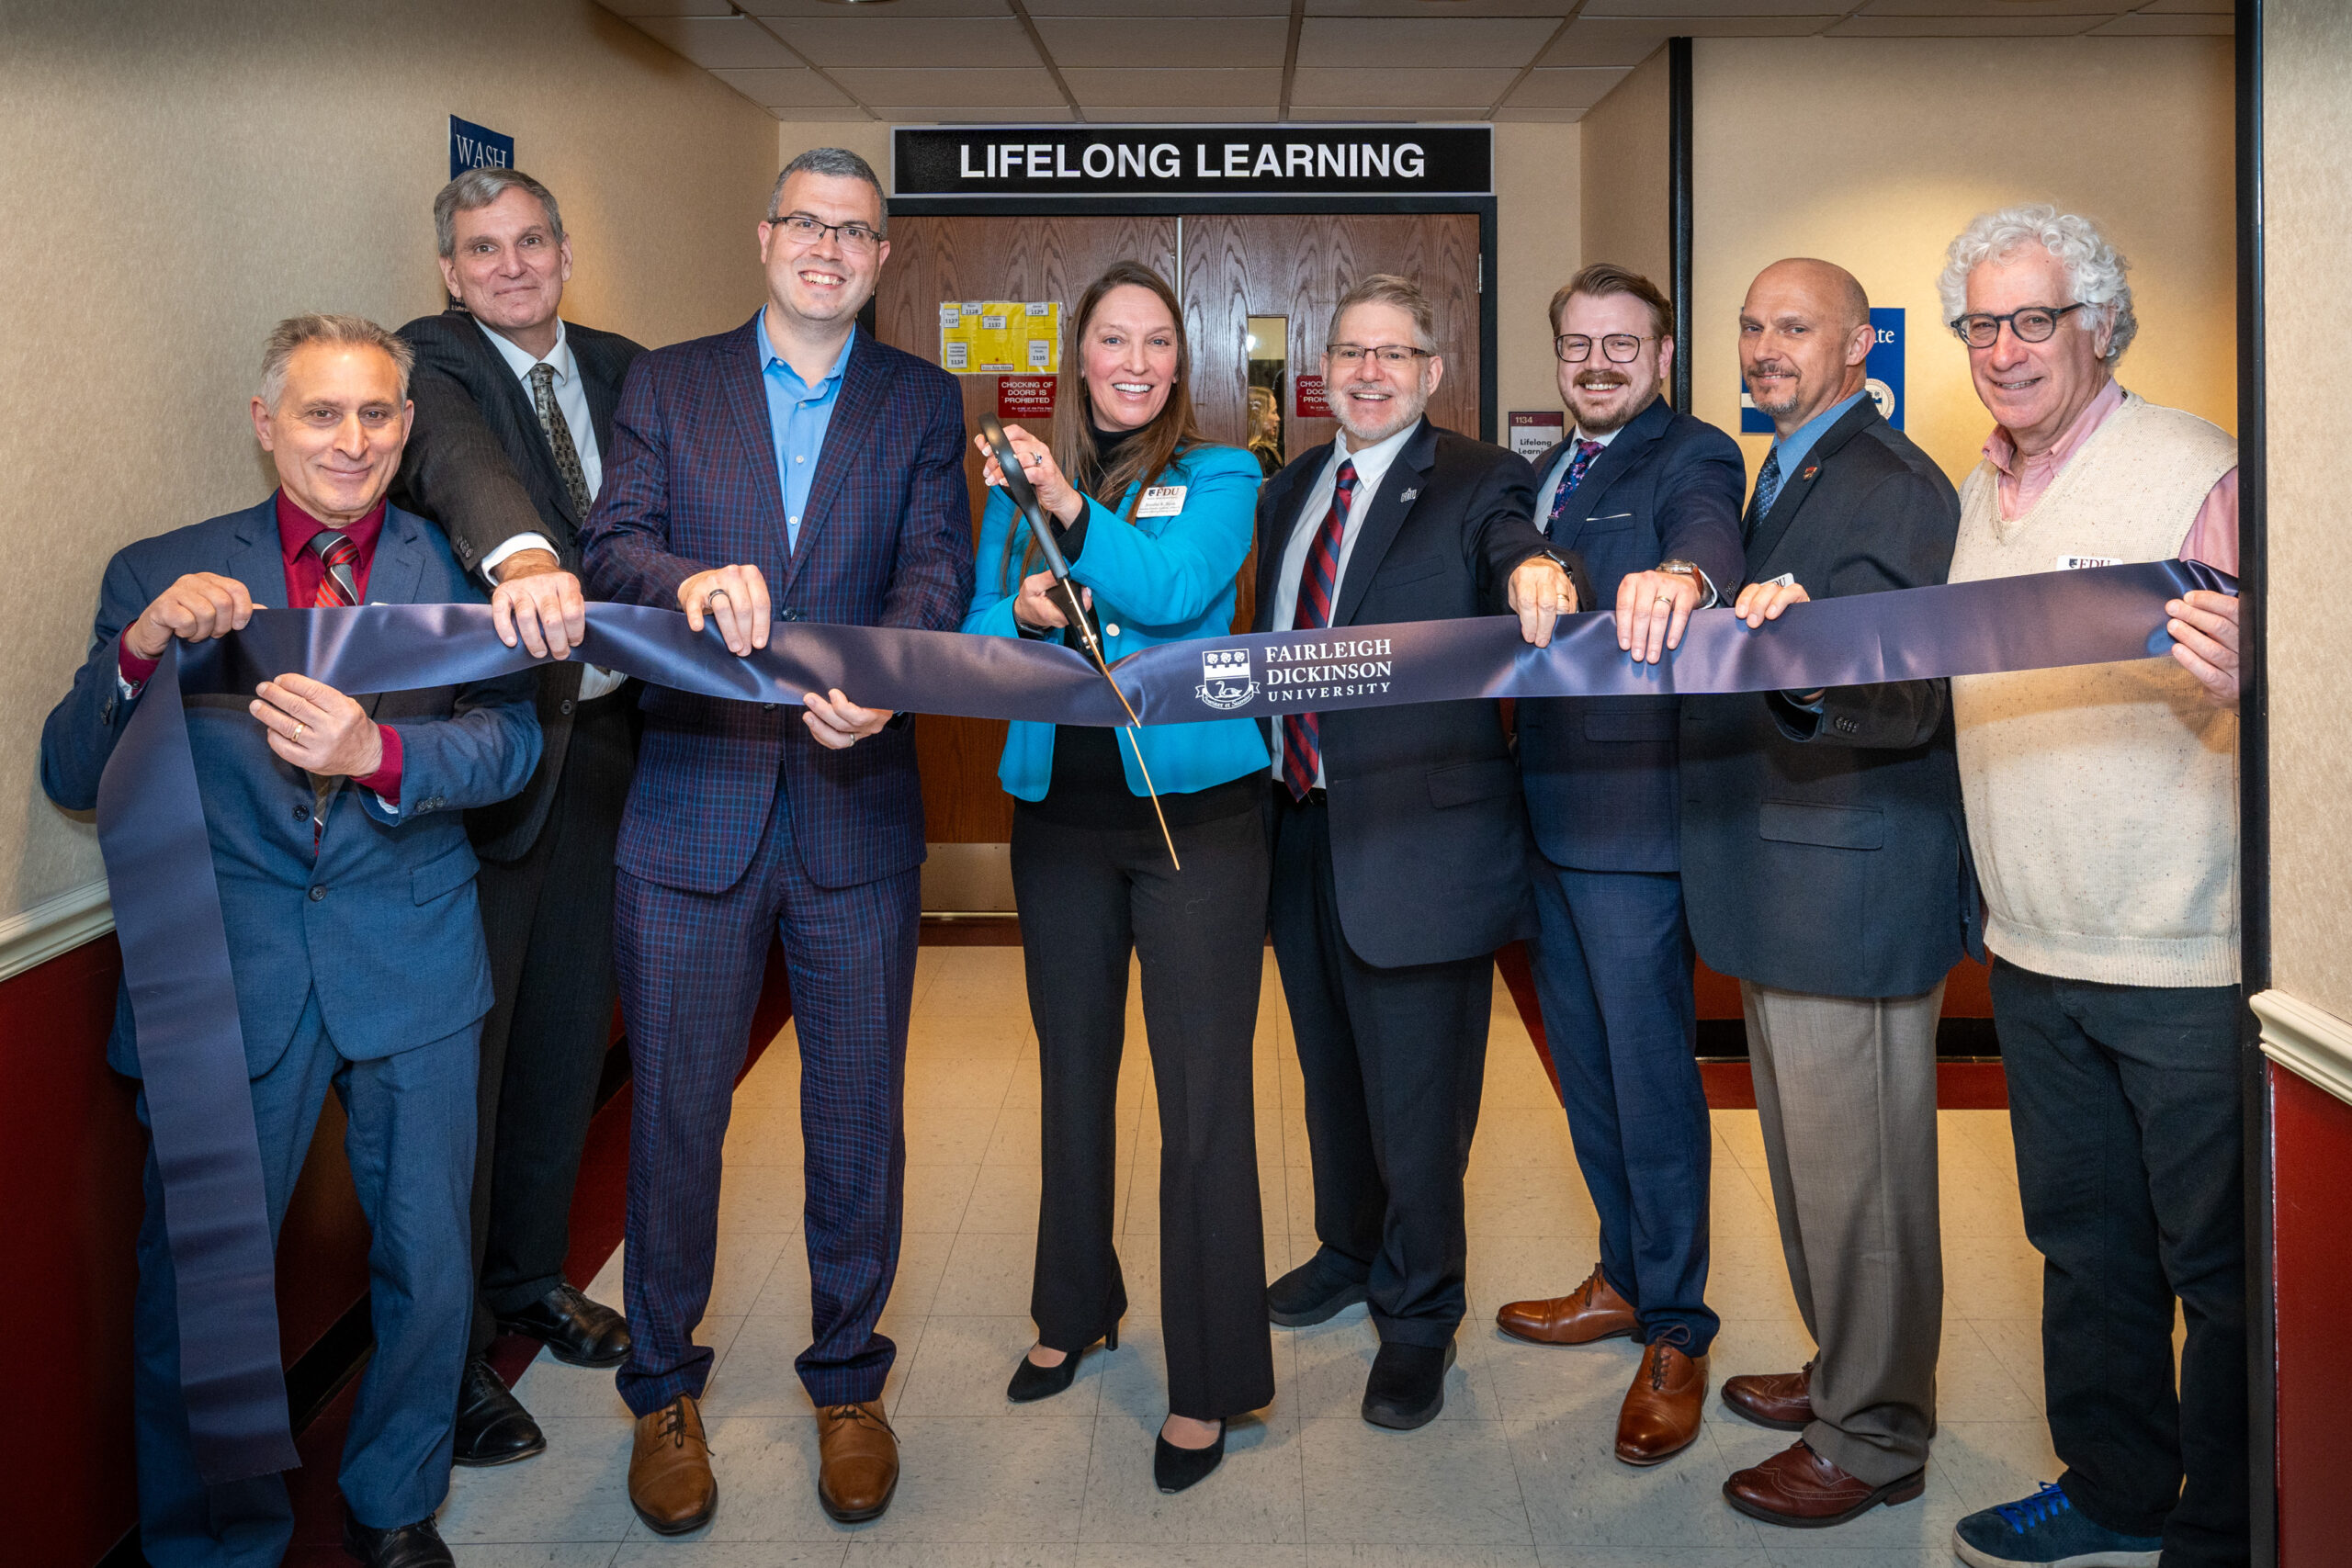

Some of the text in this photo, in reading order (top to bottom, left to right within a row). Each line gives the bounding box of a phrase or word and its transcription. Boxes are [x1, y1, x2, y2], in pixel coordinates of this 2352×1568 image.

[456, 134, 506, 168] WASH
[960, 142, 1425, 178] LIFELONG LEARNING
[1520, 438, 1552, 447] Lifelong
[1156, 488, 1180, 496] FDU
[1264, 638, 1392, 663] FAIRLEIGH
[1266, 660, 1392, 686] DICKINSON
[1268, 682, 1391, 703] UNIVERSITY
